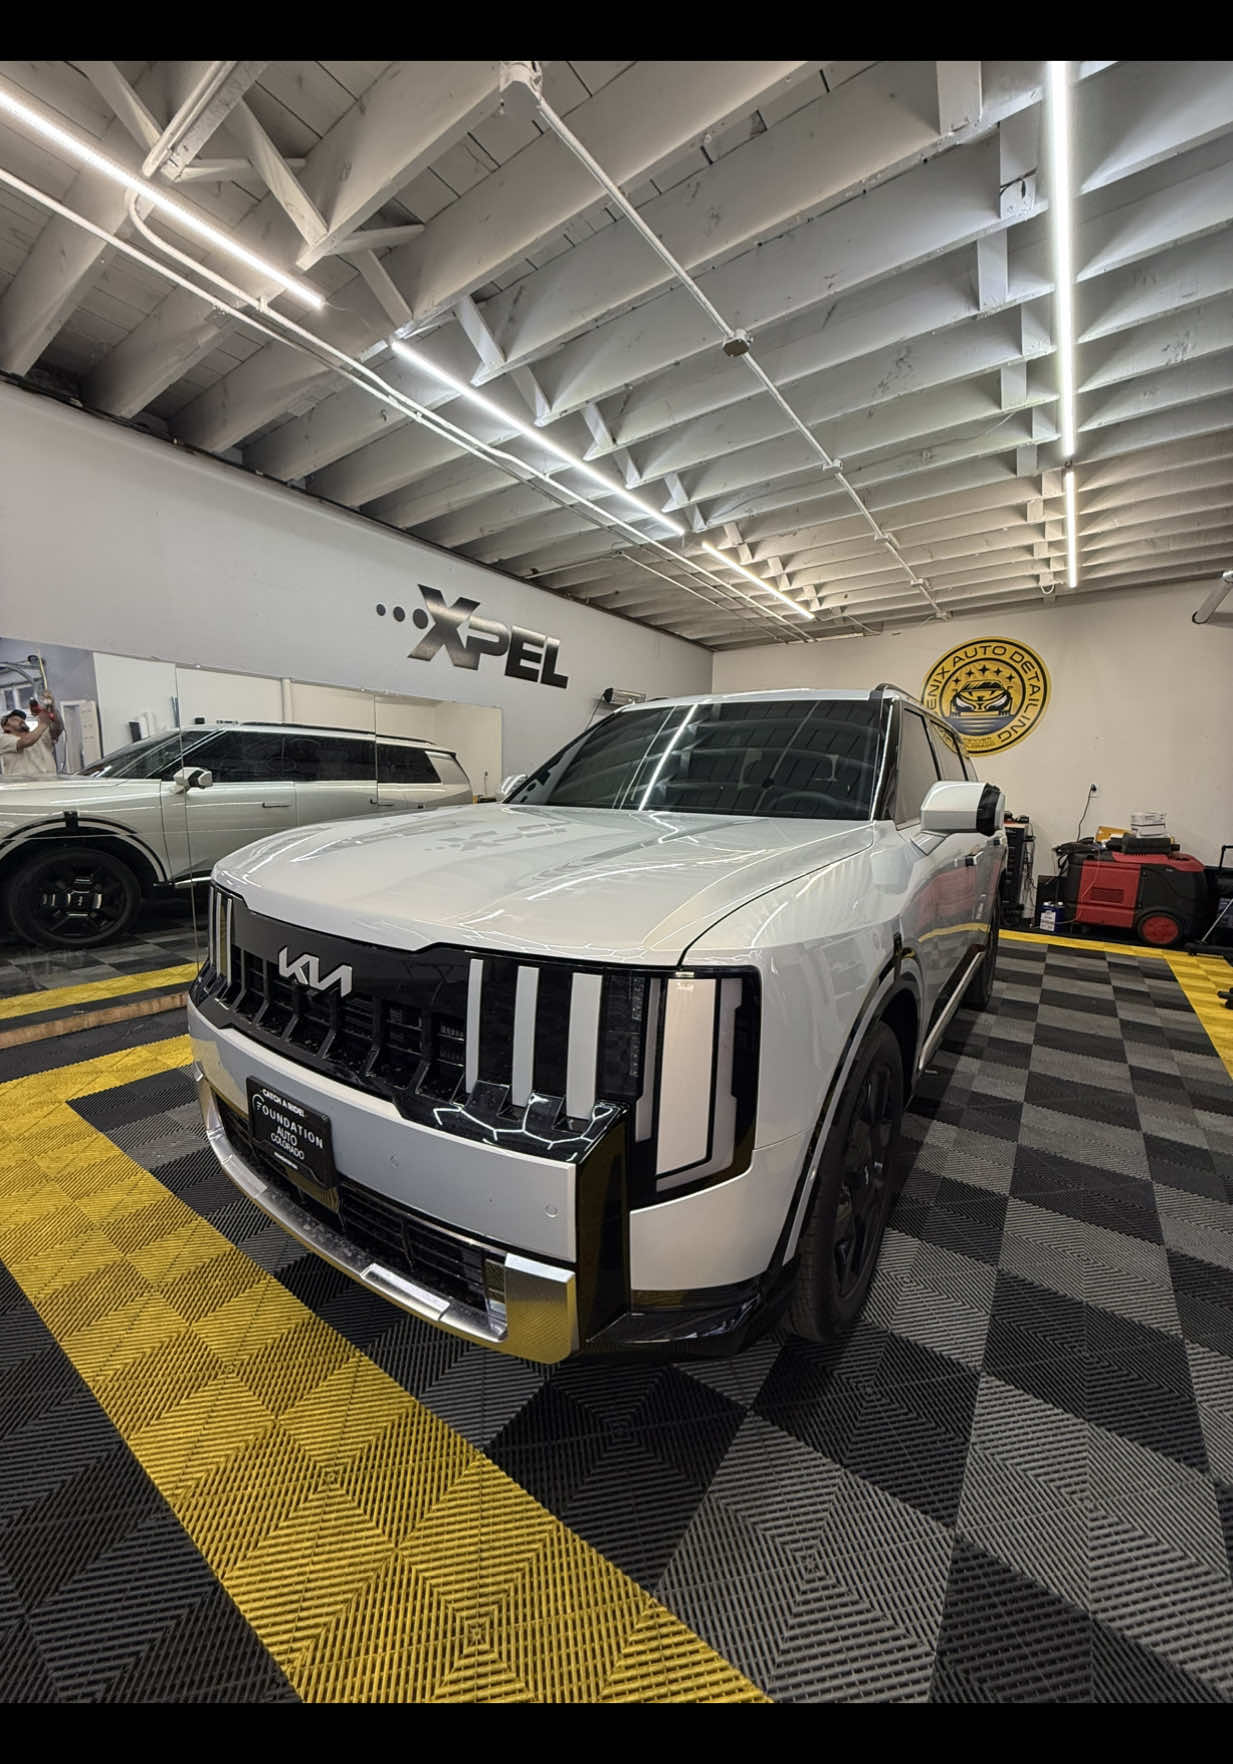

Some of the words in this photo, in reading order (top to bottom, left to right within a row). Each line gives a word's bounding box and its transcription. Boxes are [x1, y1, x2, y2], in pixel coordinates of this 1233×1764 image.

[407, 583, 569, 689] XPEL
[952, 645, 1007, 667] AUTO
[998, 650, 1041, 742] DETAILING
[279, 946, 353, 998] KIA
[256, 1100, 323, 1149] FOUNDATION
[270, 1132, 305, 1160] COLORADO
[277, 1126, 298, 1146] AUTO
